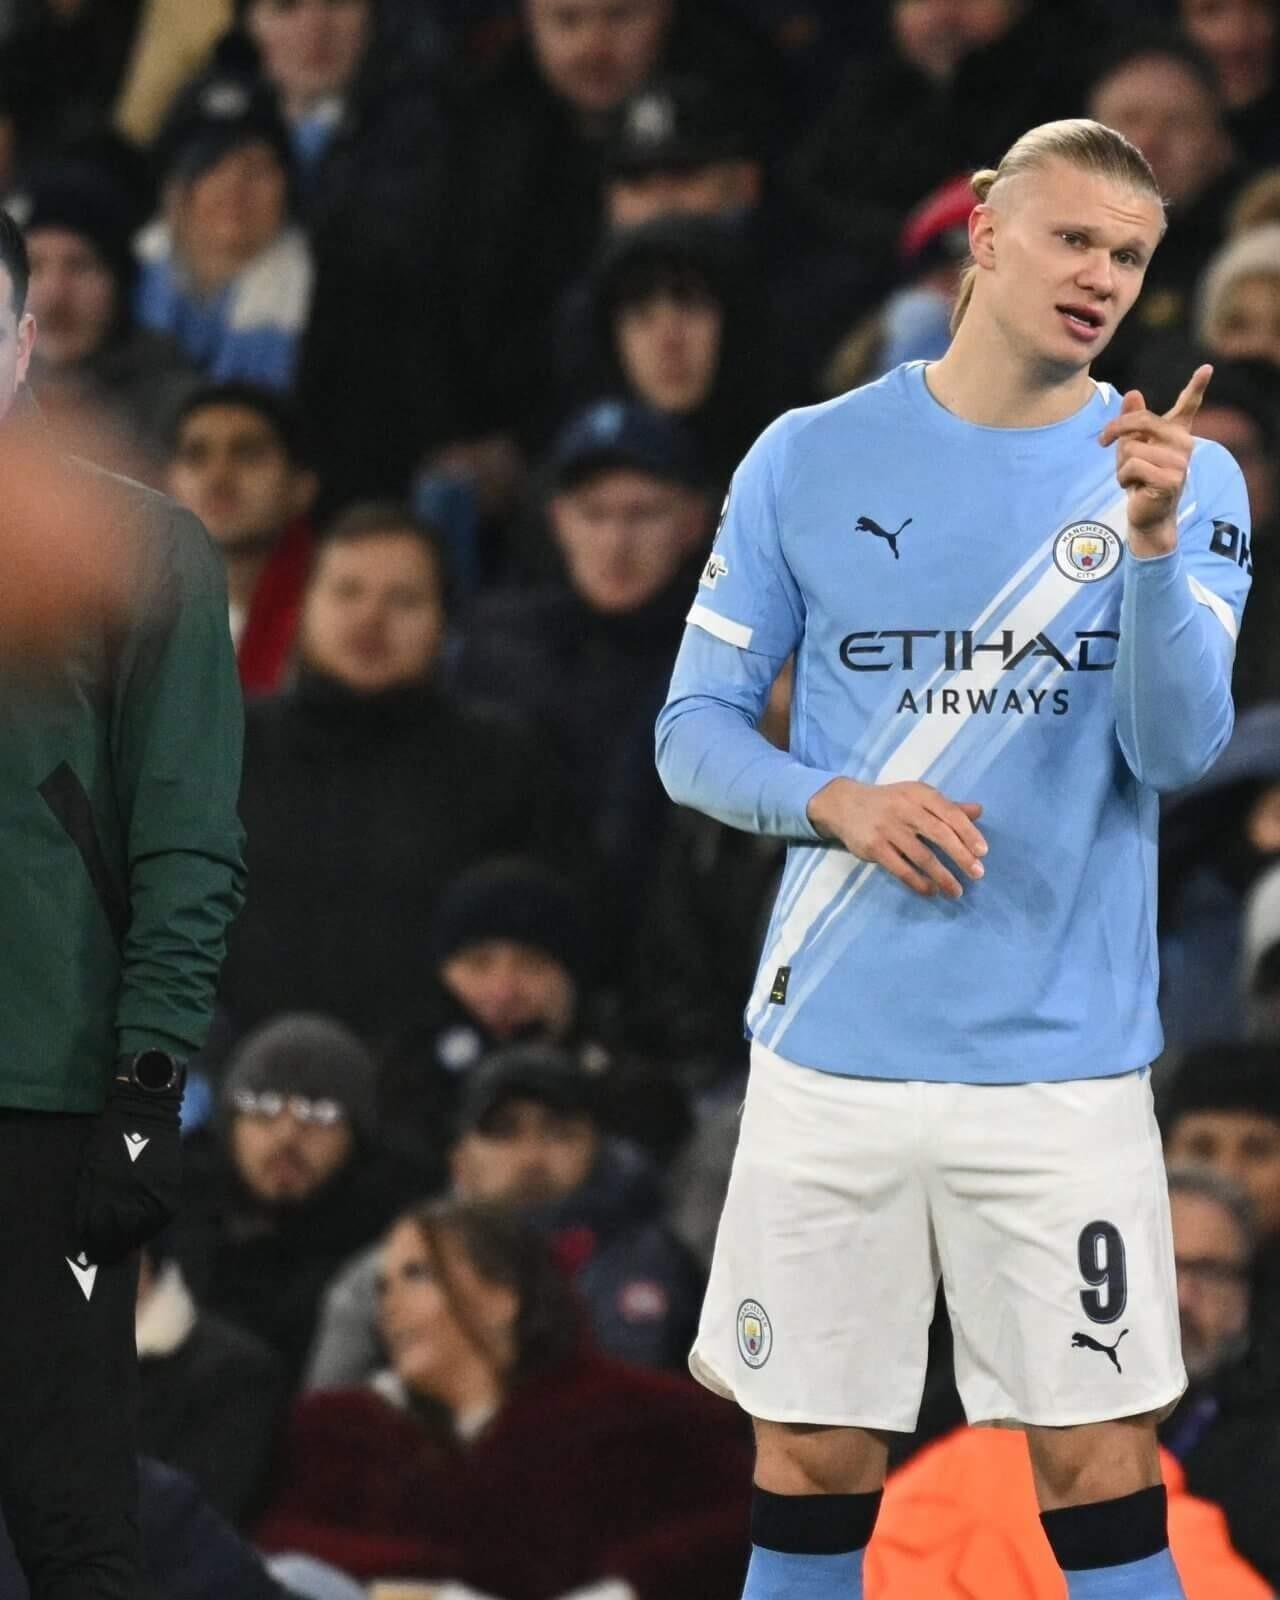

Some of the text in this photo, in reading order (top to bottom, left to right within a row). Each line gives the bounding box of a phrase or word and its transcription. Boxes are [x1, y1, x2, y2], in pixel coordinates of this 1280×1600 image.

[1062, 525, 1117, 545] MANCHESTER
[838, 629, 1121, 672] ETIHAD
[896, 687, 1070, 716] AIRWAYS
[1077, 1219, 1128, 1325] 9
